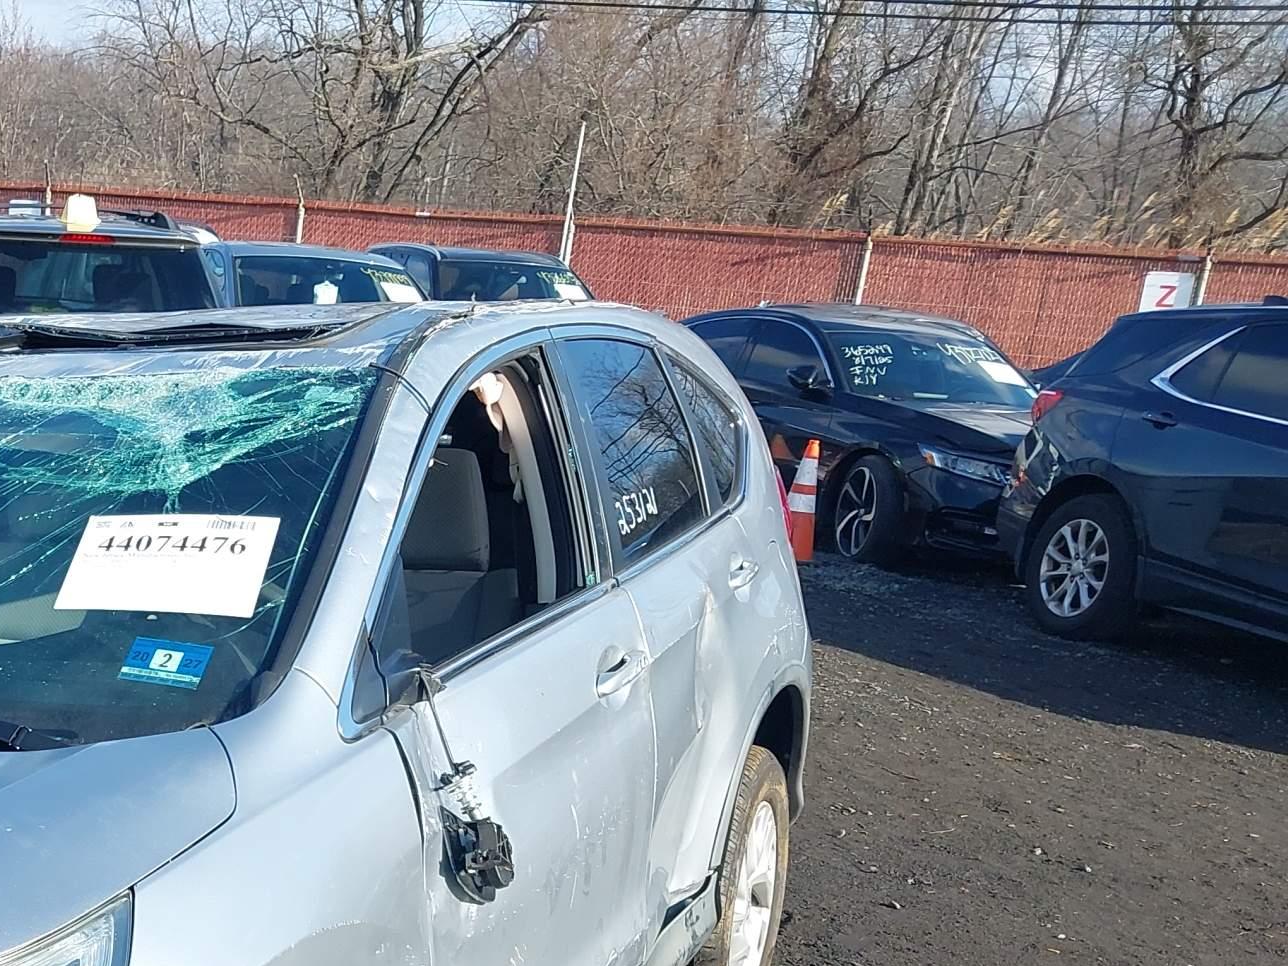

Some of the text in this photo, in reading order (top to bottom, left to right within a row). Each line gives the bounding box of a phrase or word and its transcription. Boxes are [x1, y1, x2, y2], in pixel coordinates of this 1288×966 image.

[1155, 285, 1177, 308] Z
[98, 534, 247, 555] 44074476
[132, 650, 202, 669] 20 2 27
